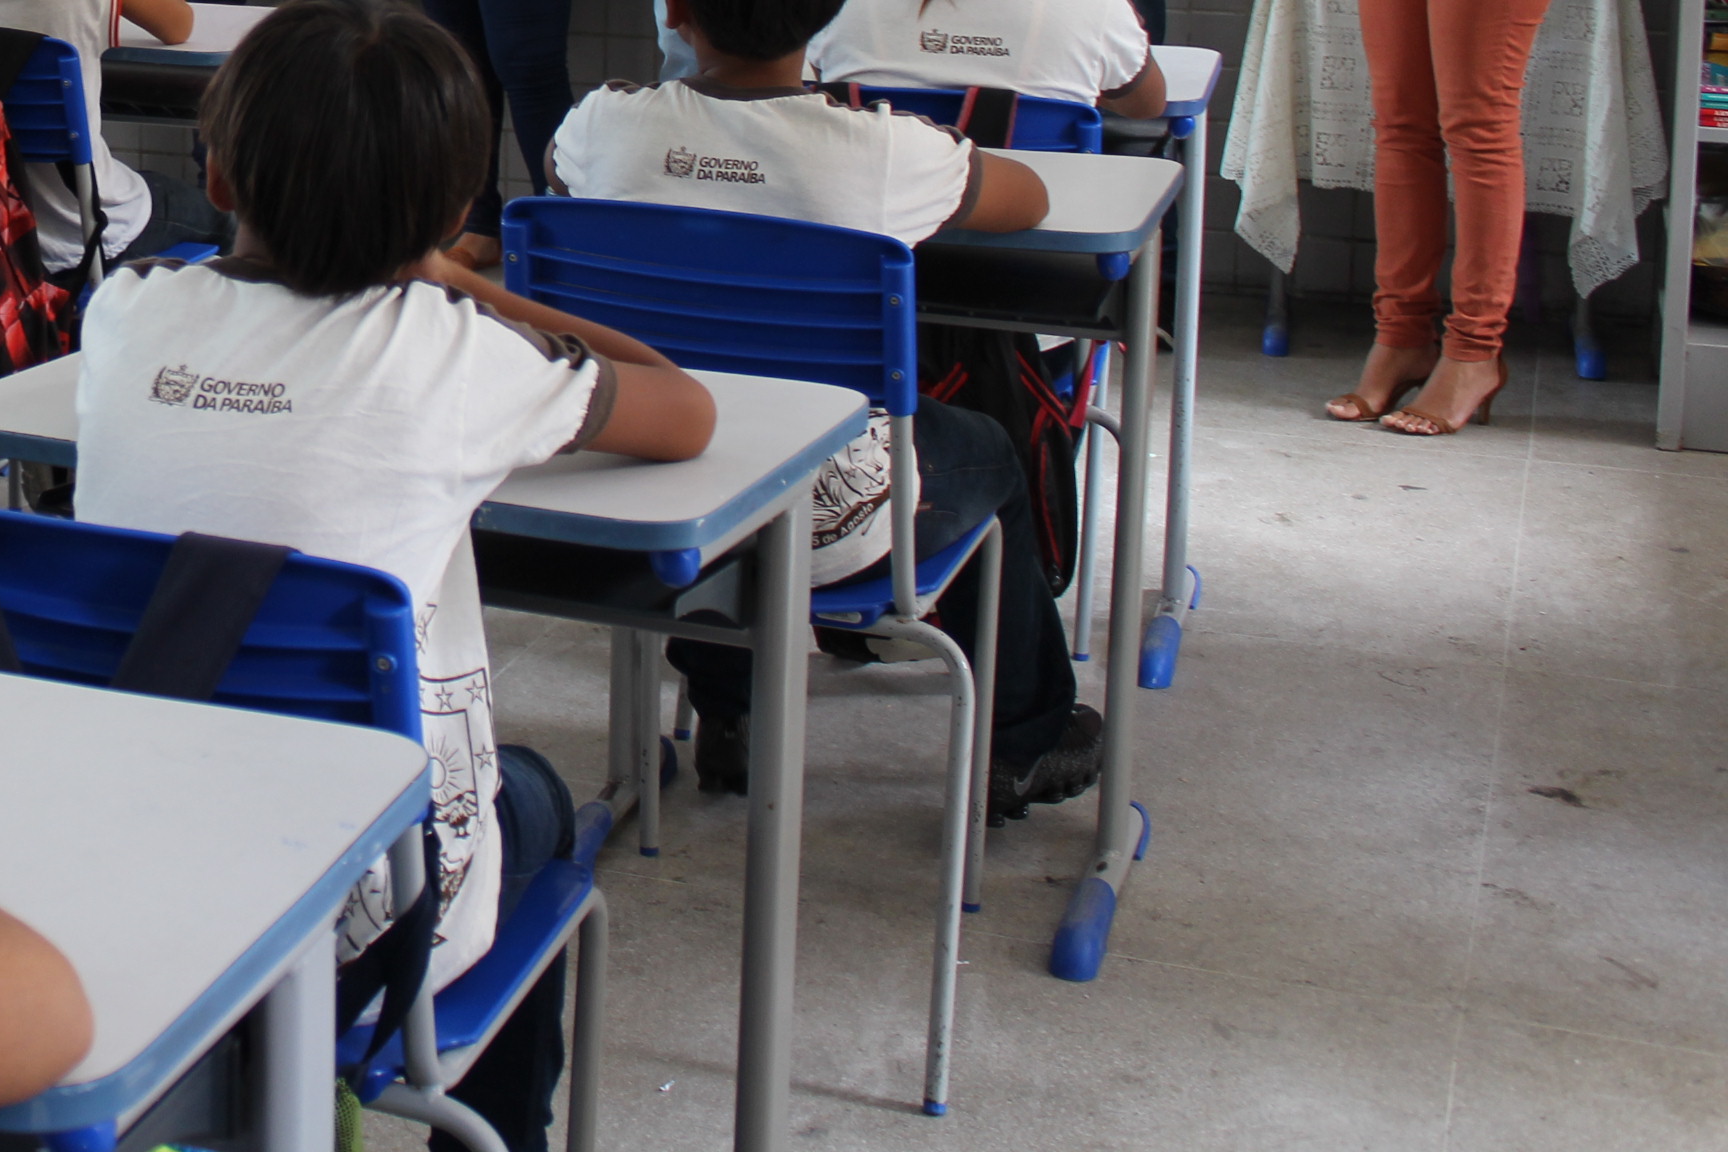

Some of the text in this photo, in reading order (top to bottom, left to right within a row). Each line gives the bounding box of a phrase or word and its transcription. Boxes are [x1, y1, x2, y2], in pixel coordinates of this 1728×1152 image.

[951, 35, 1003, 46] GOVERNO
[950, 45, 964, 54] DA
[699, 156, 759, 171] GOVERNO
[697, 169, 713, 181] DA
[200, 377, 286, 398] GOVERNO
[193, 394, 293, 415] DA PARAÍBA
